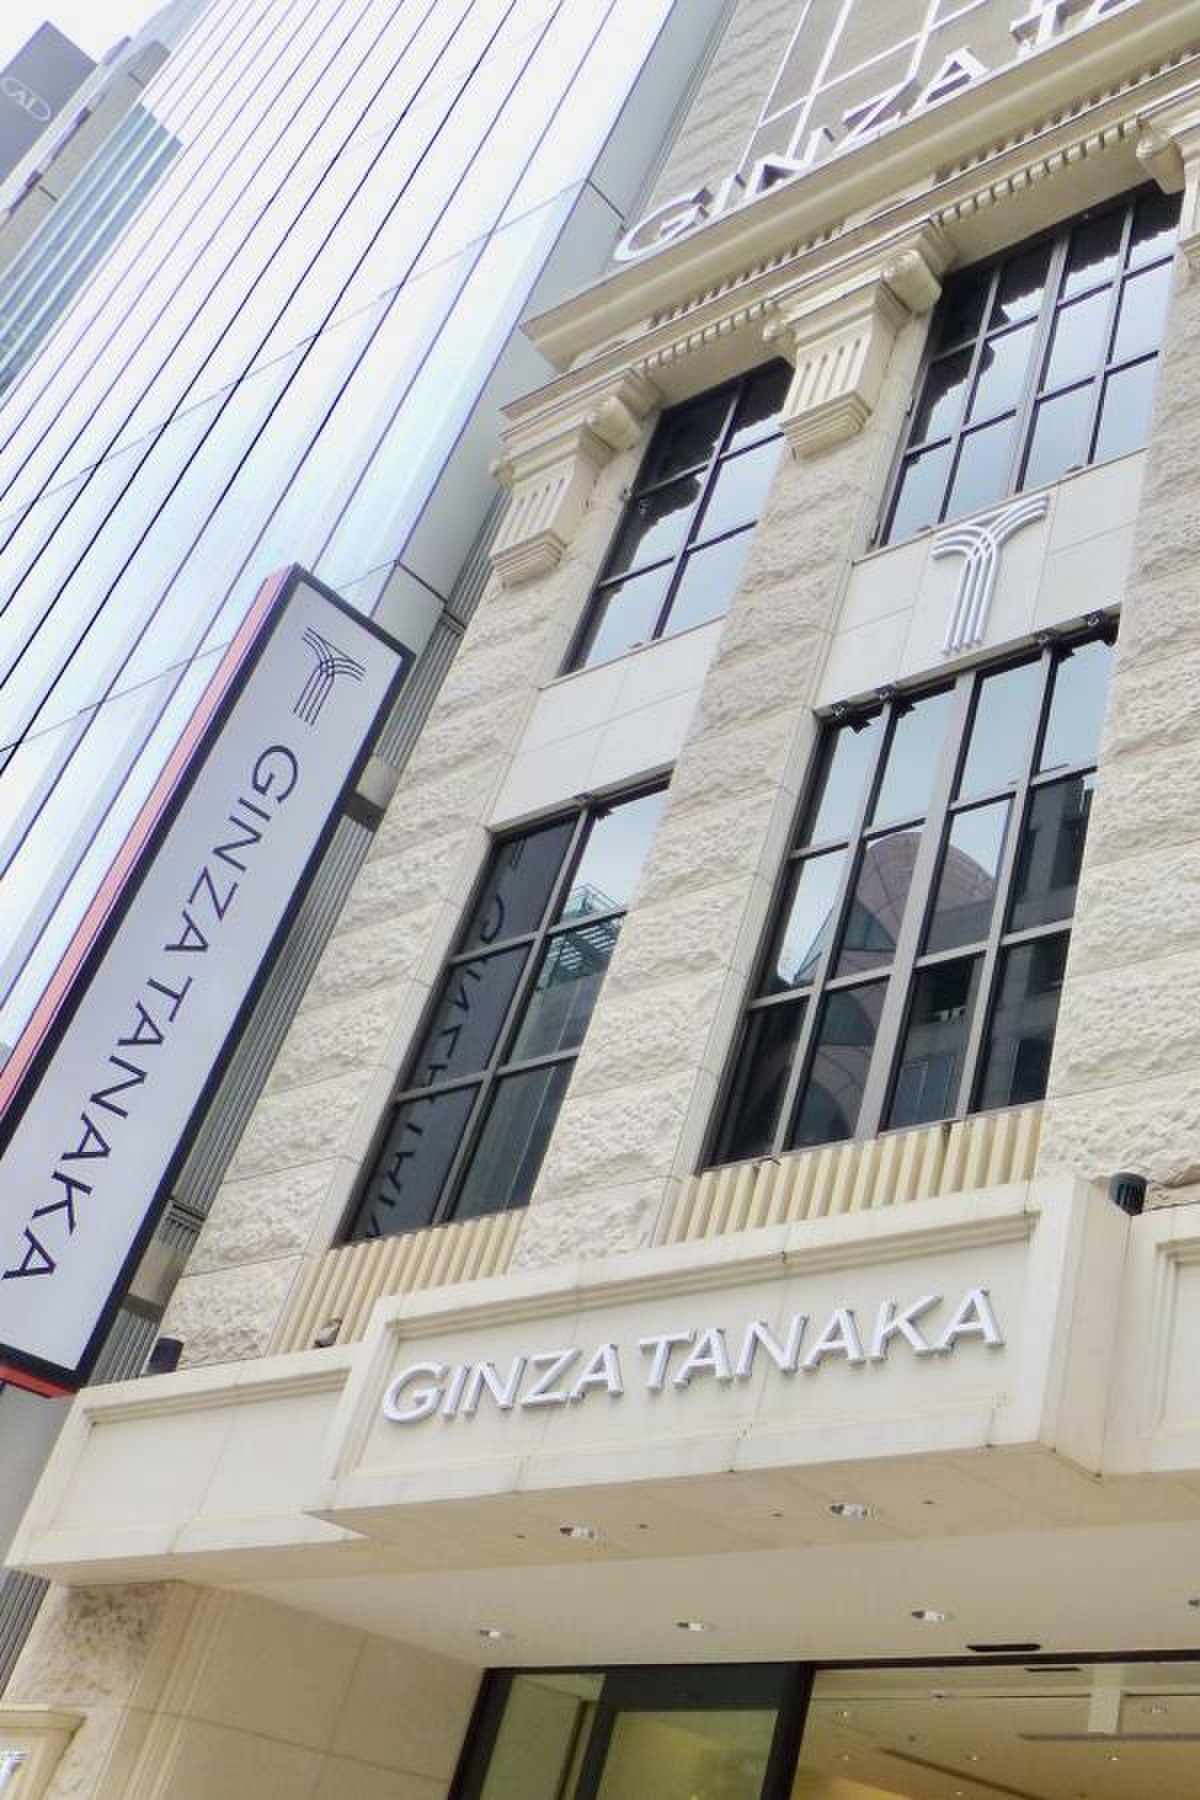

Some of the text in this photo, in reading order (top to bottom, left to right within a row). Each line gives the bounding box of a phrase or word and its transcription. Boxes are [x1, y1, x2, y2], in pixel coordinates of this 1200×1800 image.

[612, 46, 988, 262] GINZA
[2, 744, 298, 1280] GINZA TANAKA
[383, 1287, 1004, 1424] GINZA TANAKA
